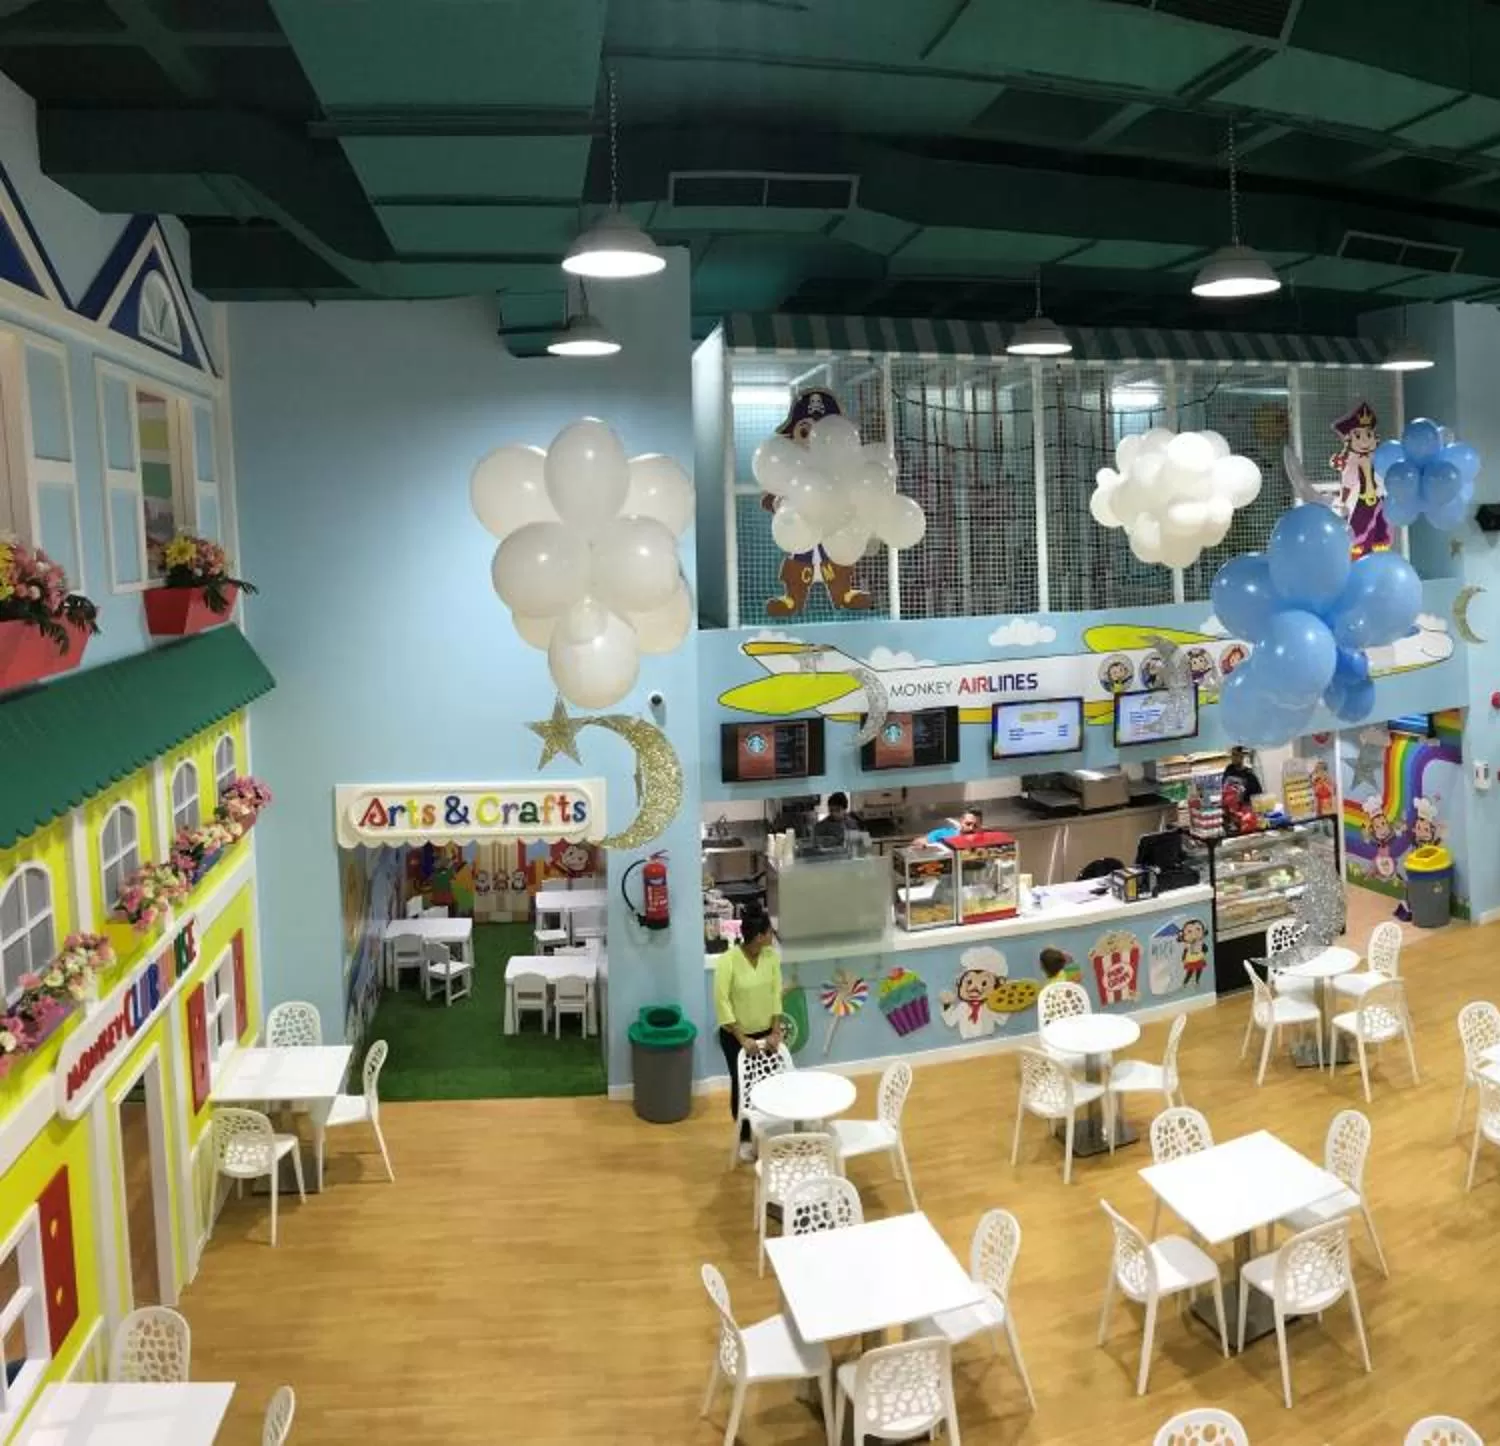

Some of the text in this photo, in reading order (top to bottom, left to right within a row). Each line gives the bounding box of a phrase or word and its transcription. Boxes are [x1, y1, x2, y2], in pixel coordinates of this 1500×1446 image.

[889, 673, 1039, 697] MONKEY AIRLINES
[358, 793, 587, 827] Arts & Crafts
